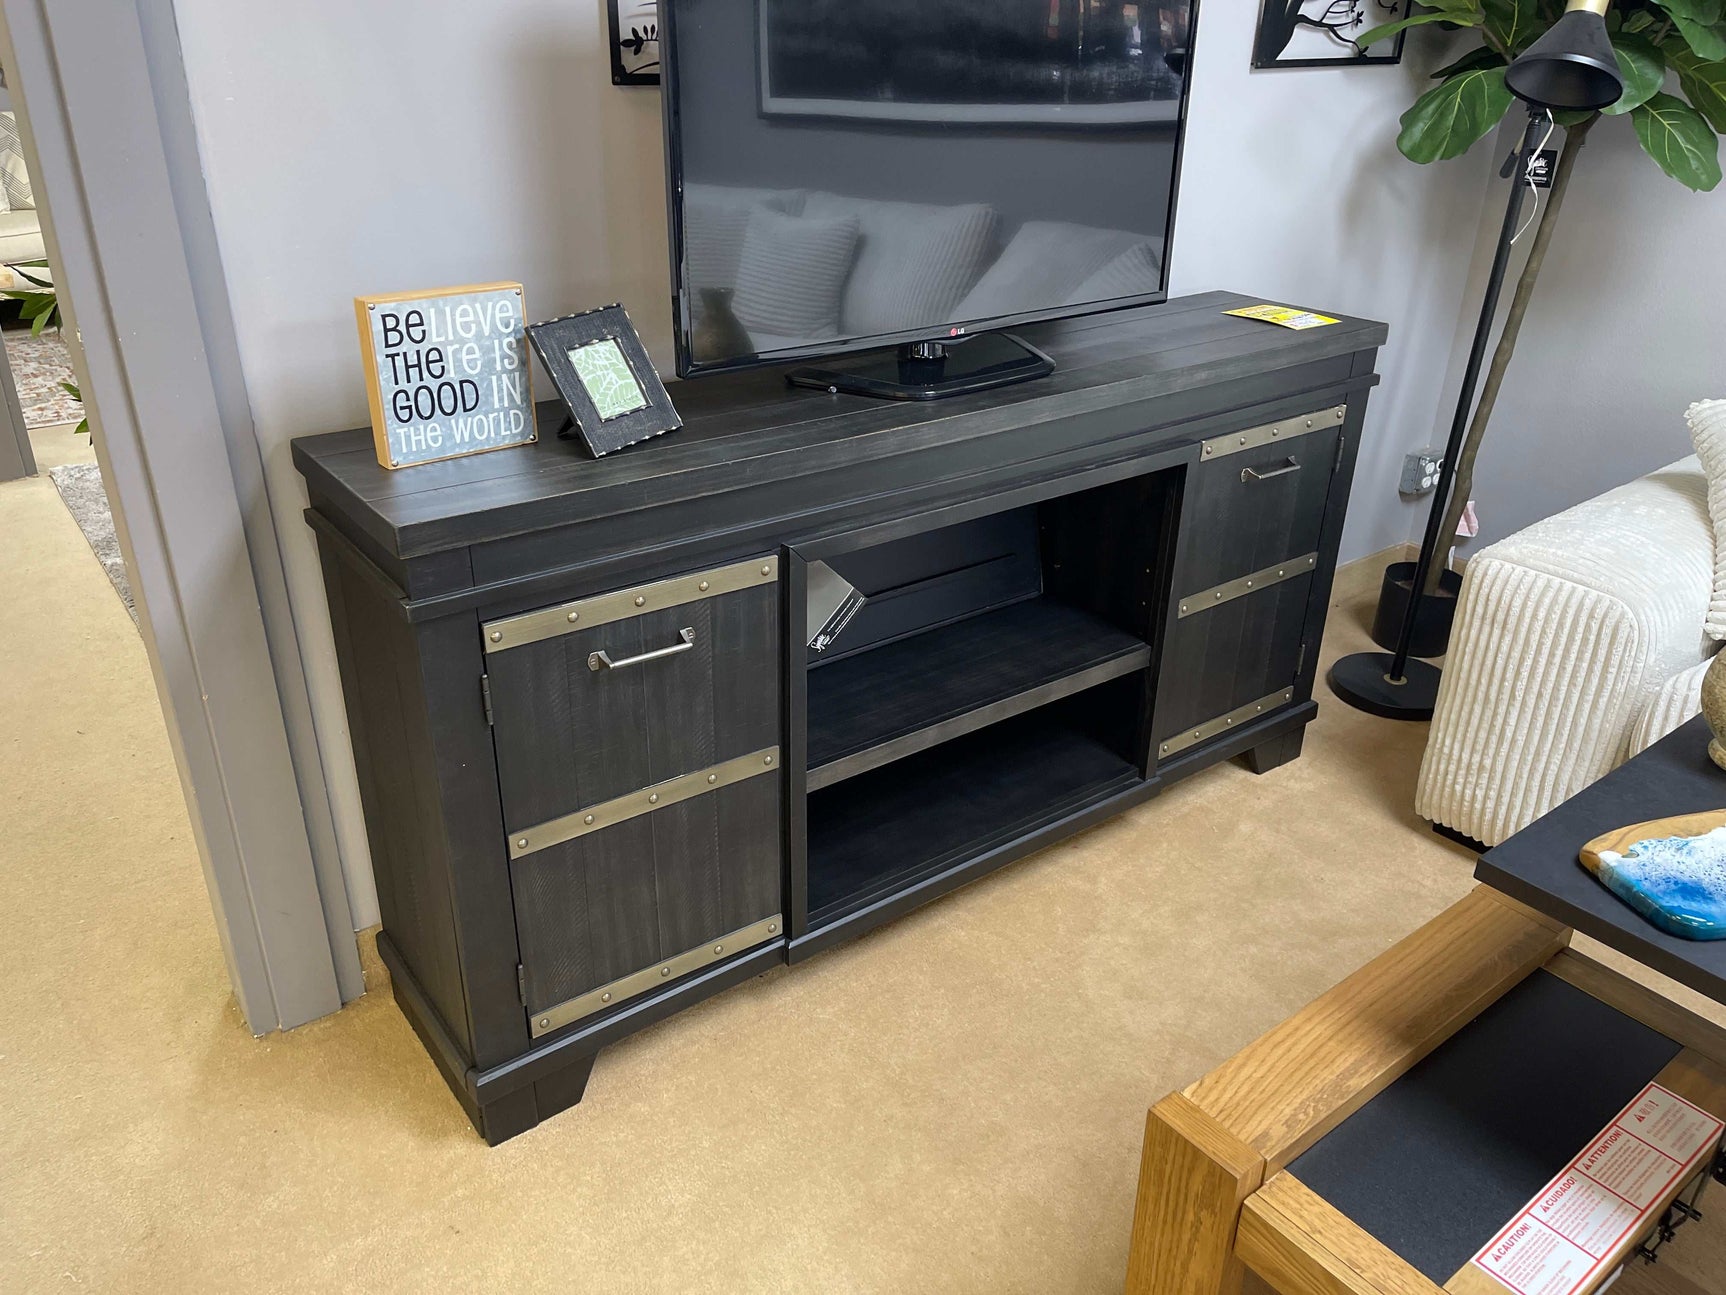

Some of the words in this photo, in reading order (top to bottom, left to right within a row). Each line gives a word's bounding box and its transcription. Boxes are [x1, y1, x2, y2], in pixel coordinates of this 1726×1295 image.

[494, 337, 519, 371] IS
[392, 379, 480, 424] GOOD
[491, 372, 522, 409] IN
[1588, 1129, 1623, 1165] ATTENTION!
[1545, 1176, 1578, 1208] CUIDADO!
[1497, 1222, 1532, 1257] CAUTION!
